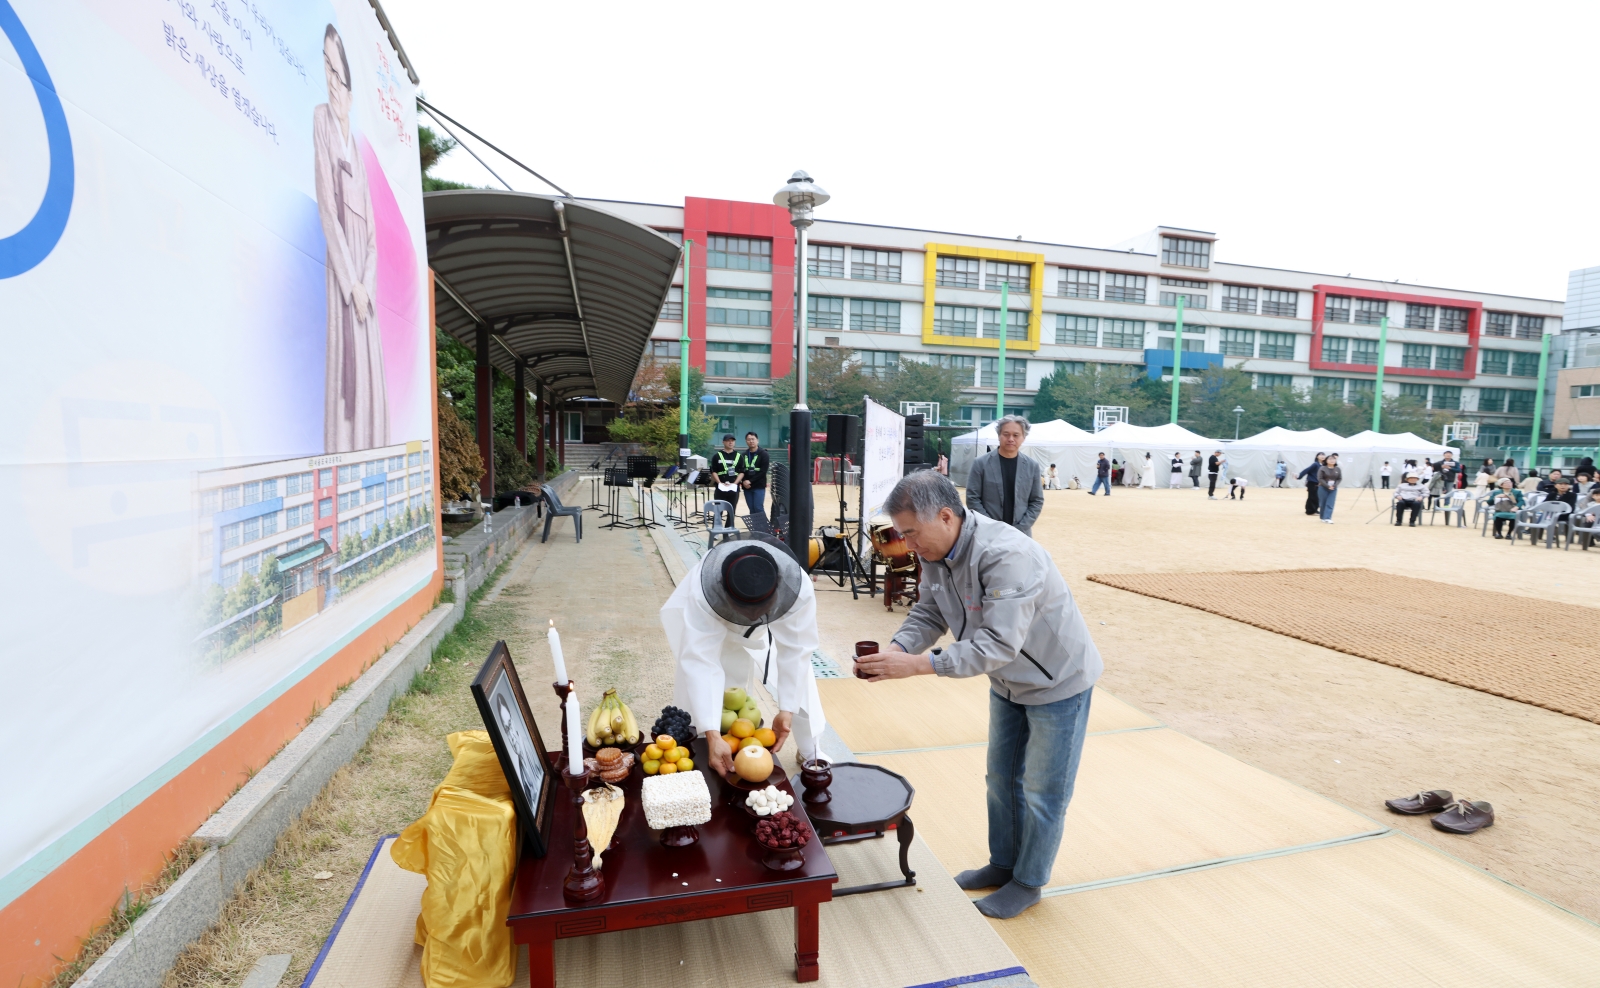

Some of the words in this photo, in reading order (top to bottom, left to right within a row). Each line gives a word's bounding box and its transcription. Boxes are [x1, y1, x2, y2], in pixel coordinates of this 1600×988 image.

[201, 19, 246, 76] 사랑으로
[233, 18, 252, 52] 이어
[250, 3, 276, 47] 우리가
[162, 19, 191, 64] 밝은
[194, 52, 229, 99] 세상을
[231, 86, 280, 146] 열겠습니다.
